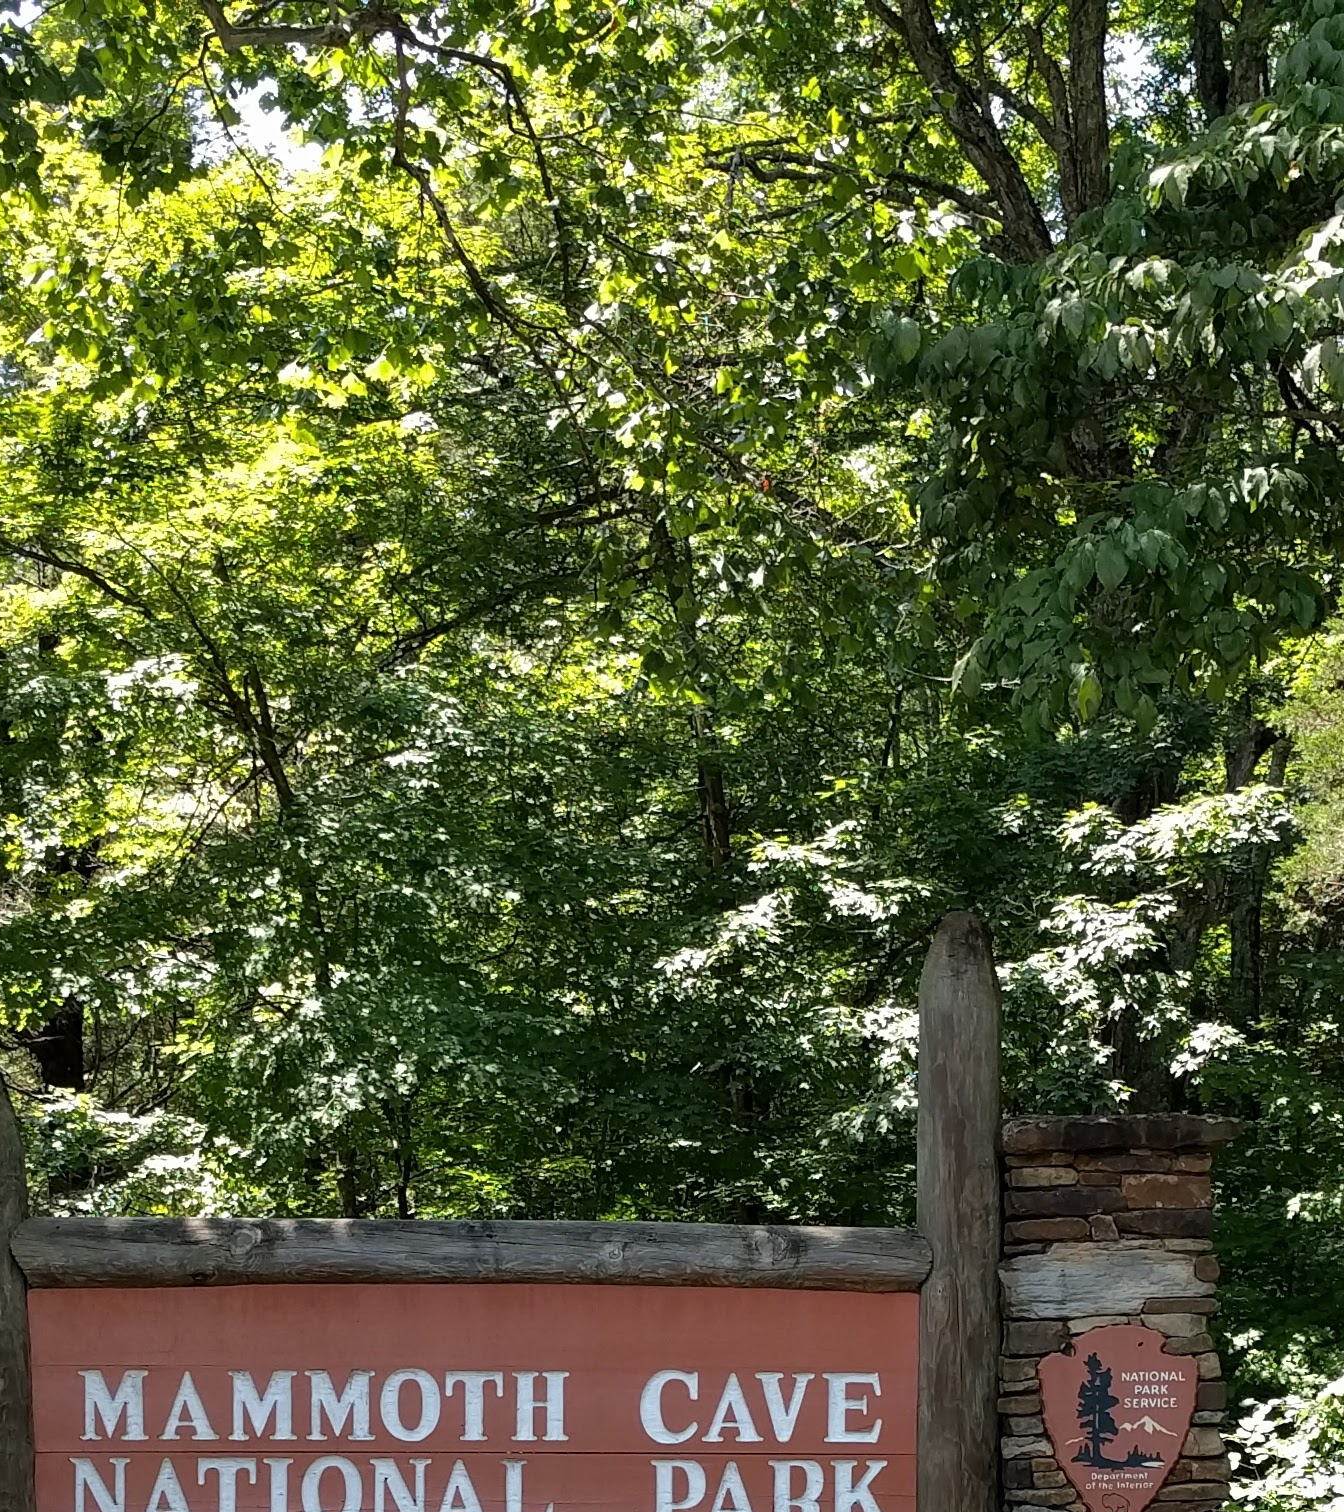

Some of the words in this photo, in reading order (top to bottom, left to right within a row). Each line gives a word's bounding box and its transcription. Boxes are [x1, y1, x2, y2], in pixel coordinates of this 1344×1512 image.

[1121, 1370, 1186, 1382] NATIONAL
[1134, 1385, 1169, 1395] PARK
[78, 1369, 569, 1441] MAMMOTH
[640, 1370, 883, 1444] CAVE
[1123, 1397, 1178, 1409] SERVICE
[1091, 1471, 1148, 1481] Department
[1085, 1481, 1096, 1490] of
[1099, 1481, 1113, 1490] the
[1116, 1481, 1154, 1489] Interior
